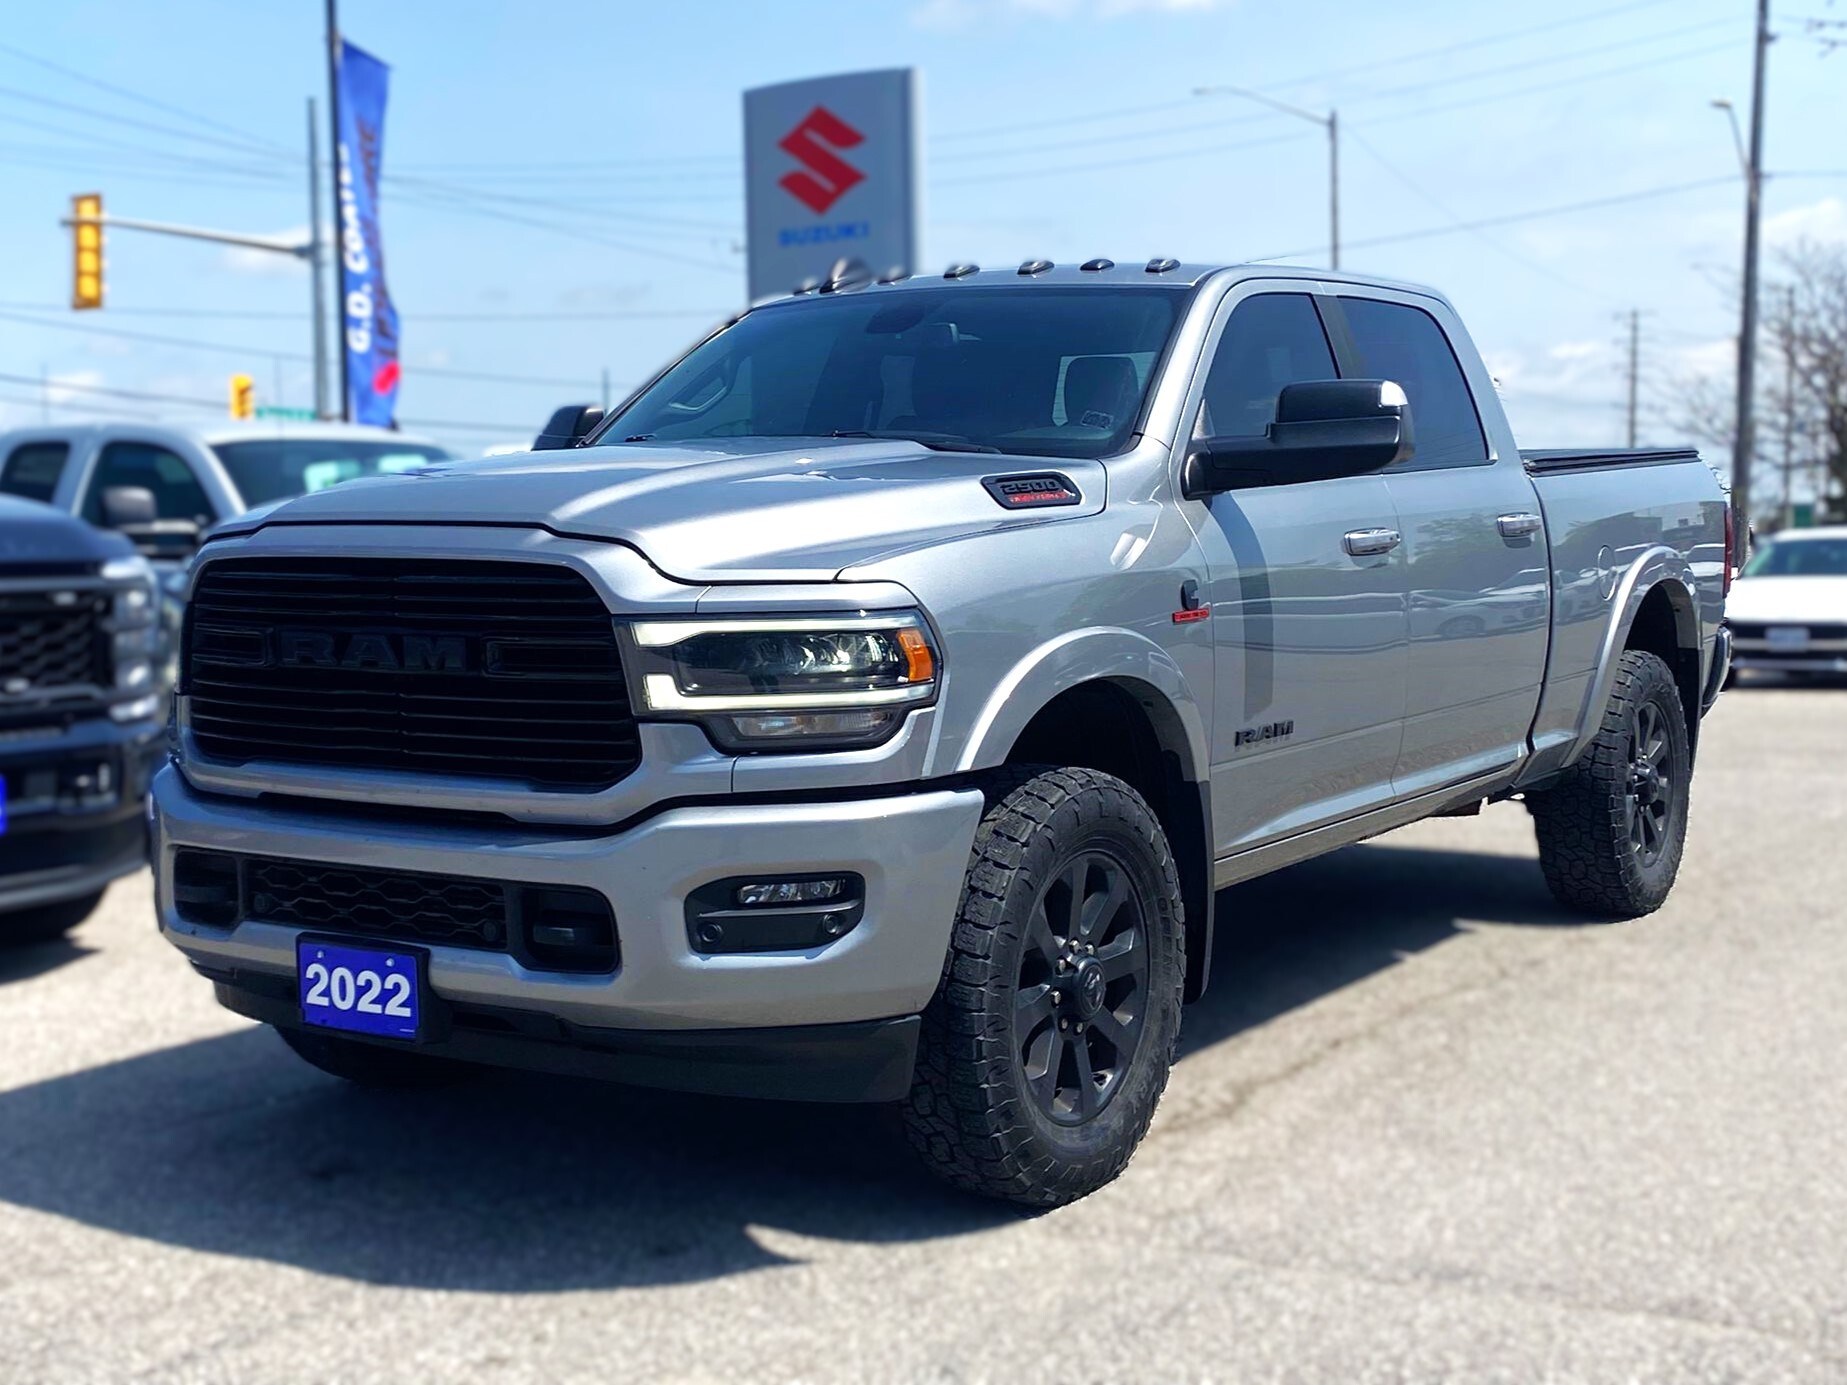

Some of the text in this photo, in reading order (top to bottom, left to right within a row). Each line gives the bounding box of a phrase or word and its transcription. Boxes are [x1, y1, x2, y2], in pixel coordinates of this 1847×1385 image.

[280, 631, 466, 672] RAM
[1235, 720, 1294, 747] RAM
[305, 962, 412, 1018] 2022
